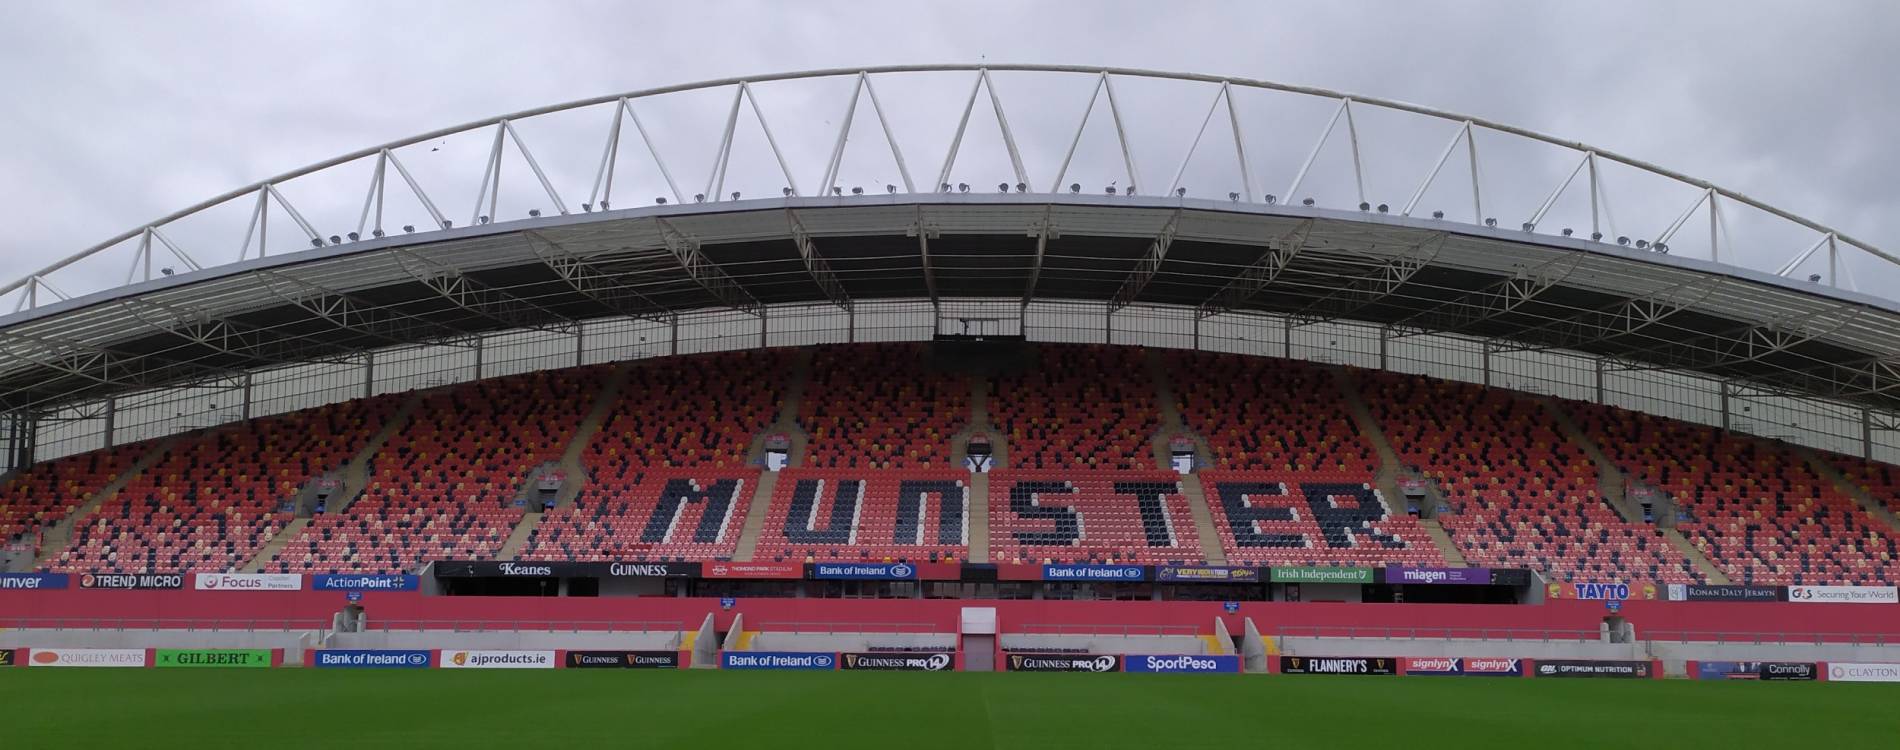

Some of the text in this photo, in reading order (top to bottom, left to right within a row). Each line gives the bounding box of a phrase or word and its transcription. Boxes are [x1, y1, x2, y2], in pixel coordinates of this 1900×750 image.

[640, 479, 1411, 548] MUNSTER
[499, 562, 551, 575] Keanes
[610, 562, 667, 576] GUINNESS
[820, 565, 886, 575] Bank of Ireland
[1049, 567, 1123, 577] Bank of Ireland
[1278, 570, 1358, 580] Irish Independent
[1404, 569, 1446, 583] miagen
[96, 575, 181, 588] TREND MICRO
[222, 576, 262, 588] Focus
[326, 577, 391, 588] ActionPoint
[1575, 583, 1630, 600] TAYTO
[1689, 588, 1775, 597] RONAN DALY JERMYN
[1817, 591, 1894, 600] Securing Your World
[61, 653, 143, 664] QUIGLEY MEATS
[177, 653, 249, 665] GILBERT
[322, 653, 406, 665] Bank of Ireland
[471, 653, 546, 665] ajproducts.ie
[583, 656, 618, 664] GUINNESS
[635, 656, 671, 664] GUINNESS
[729, 655, 812, 666] Bank of Ireland
[859, 658, 904, 667] GUINNESS
[1024, 659, 1070, 668] GUINNESS
[1147, 656, 1217, 671] SportPesa
[1310, 659, 1367, 673] FLANNERY'S
[1769, 663, 1810, 676] Connolly
[1848, 668, 1898, 677] CLAYTON
